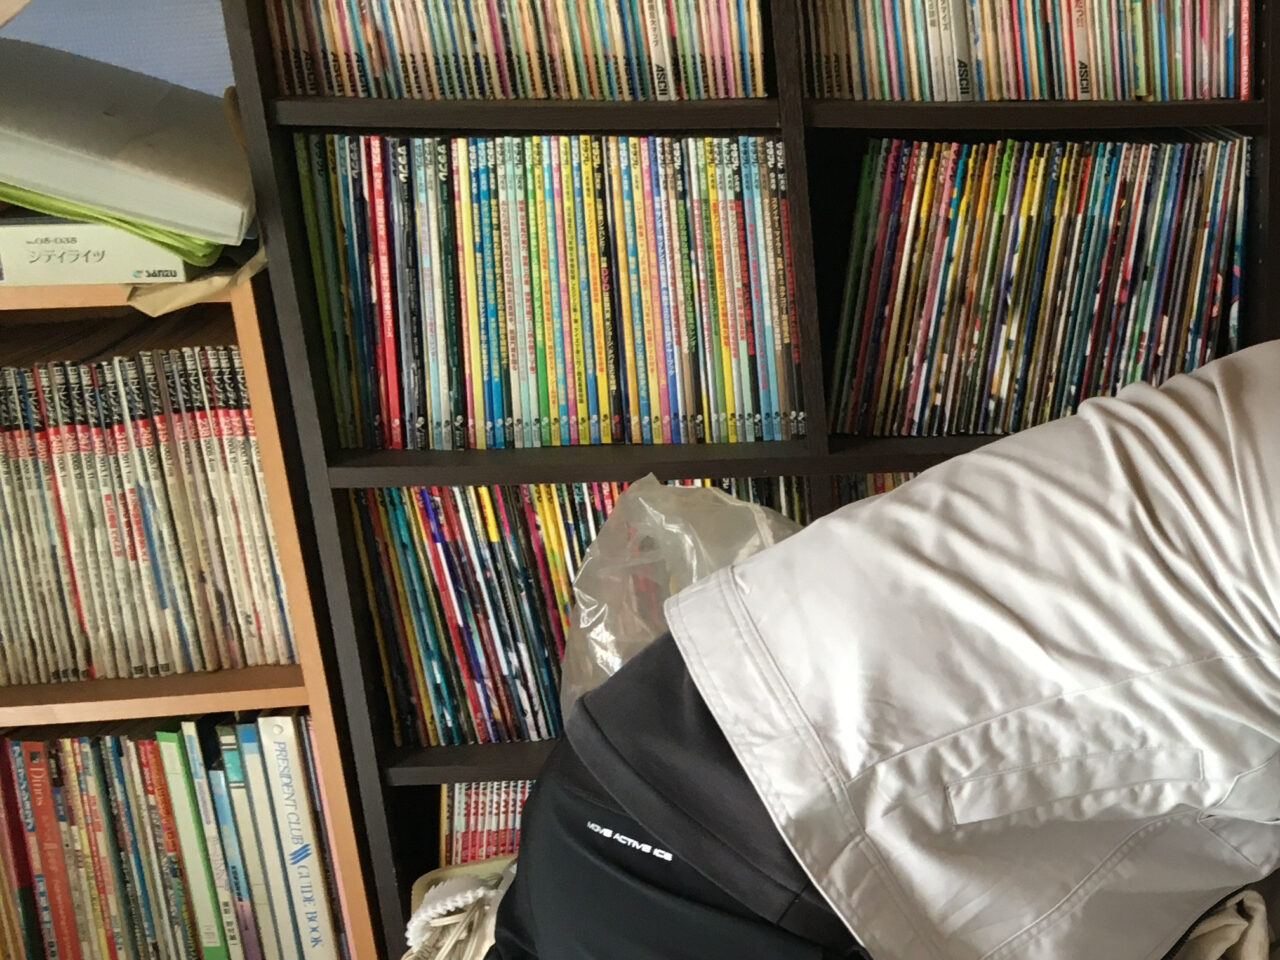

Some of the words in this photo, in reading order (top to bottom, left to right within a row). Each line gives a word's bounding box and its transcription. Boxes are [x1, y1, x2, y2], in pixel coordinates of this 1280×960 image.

[28, 250, 106, 264] シティライツ
[274, 739, 300, 812] PRESIDENT
[288, 811, 306, 847] CLUB
[613, 833, 652, 854] ACTIVE
[653, 848, 673, 861] ICE
[296, 863, 316, 908] GUIDE
[304, 910, 325, 950] BOOK
